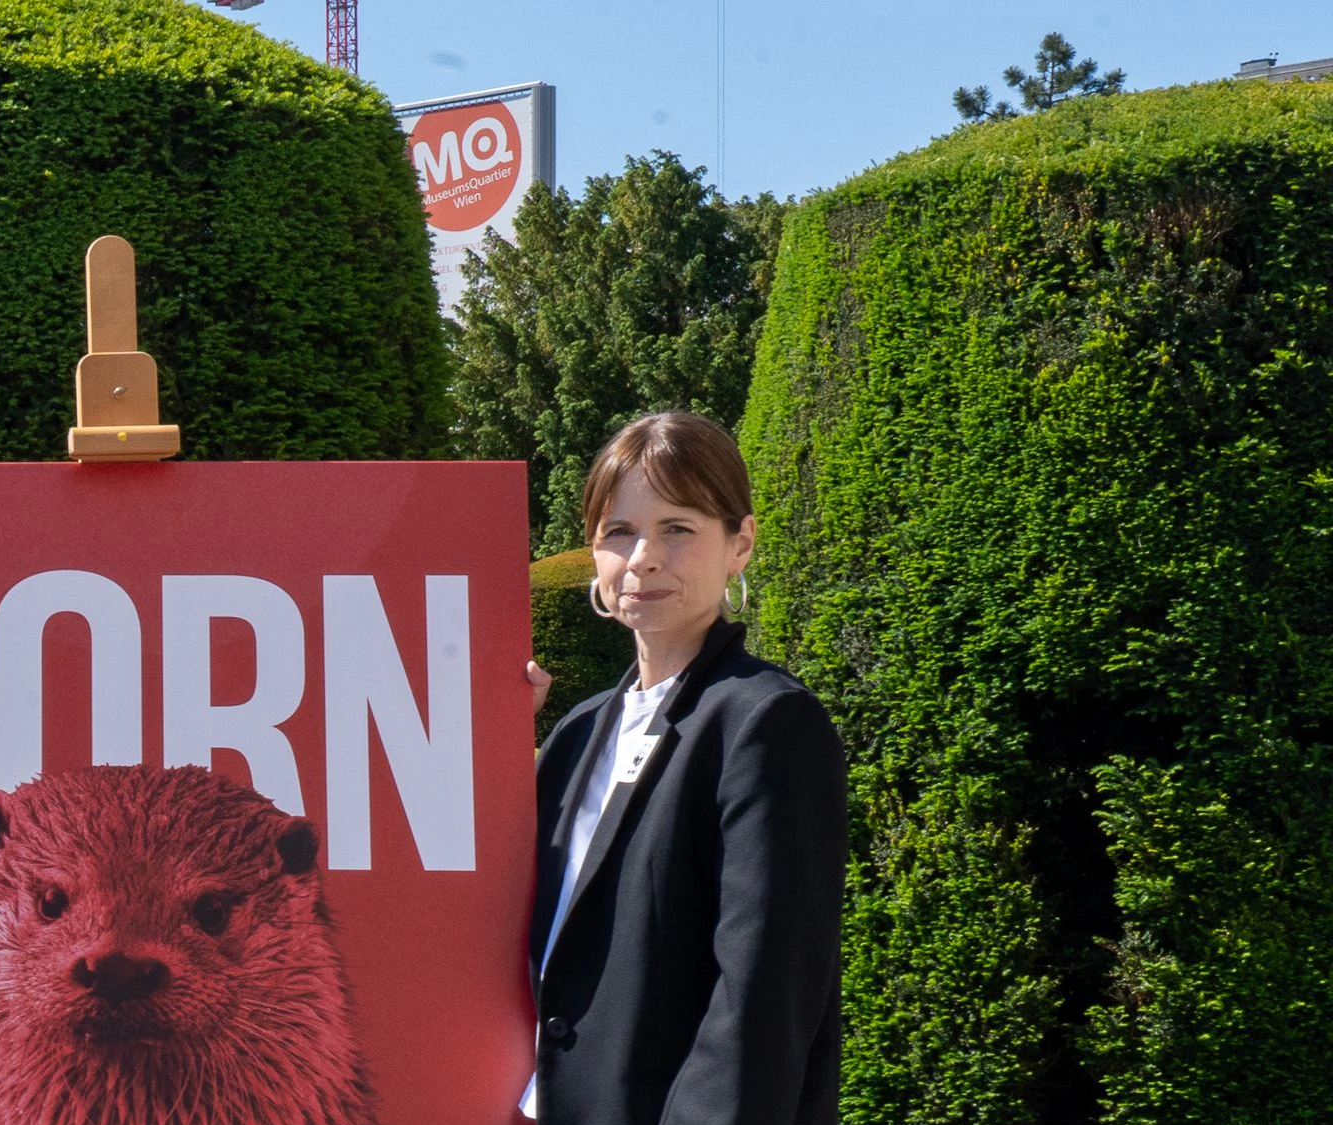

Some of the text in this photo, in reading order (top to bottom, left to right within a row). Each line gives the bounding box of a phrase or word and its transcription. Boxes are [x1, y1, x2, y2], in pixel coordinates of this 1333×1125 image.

[413, 117, 513, 192] MQ
[422, 166, 513, 206] MuseumsQuartier
[453, 192, 482, 209] Wien
